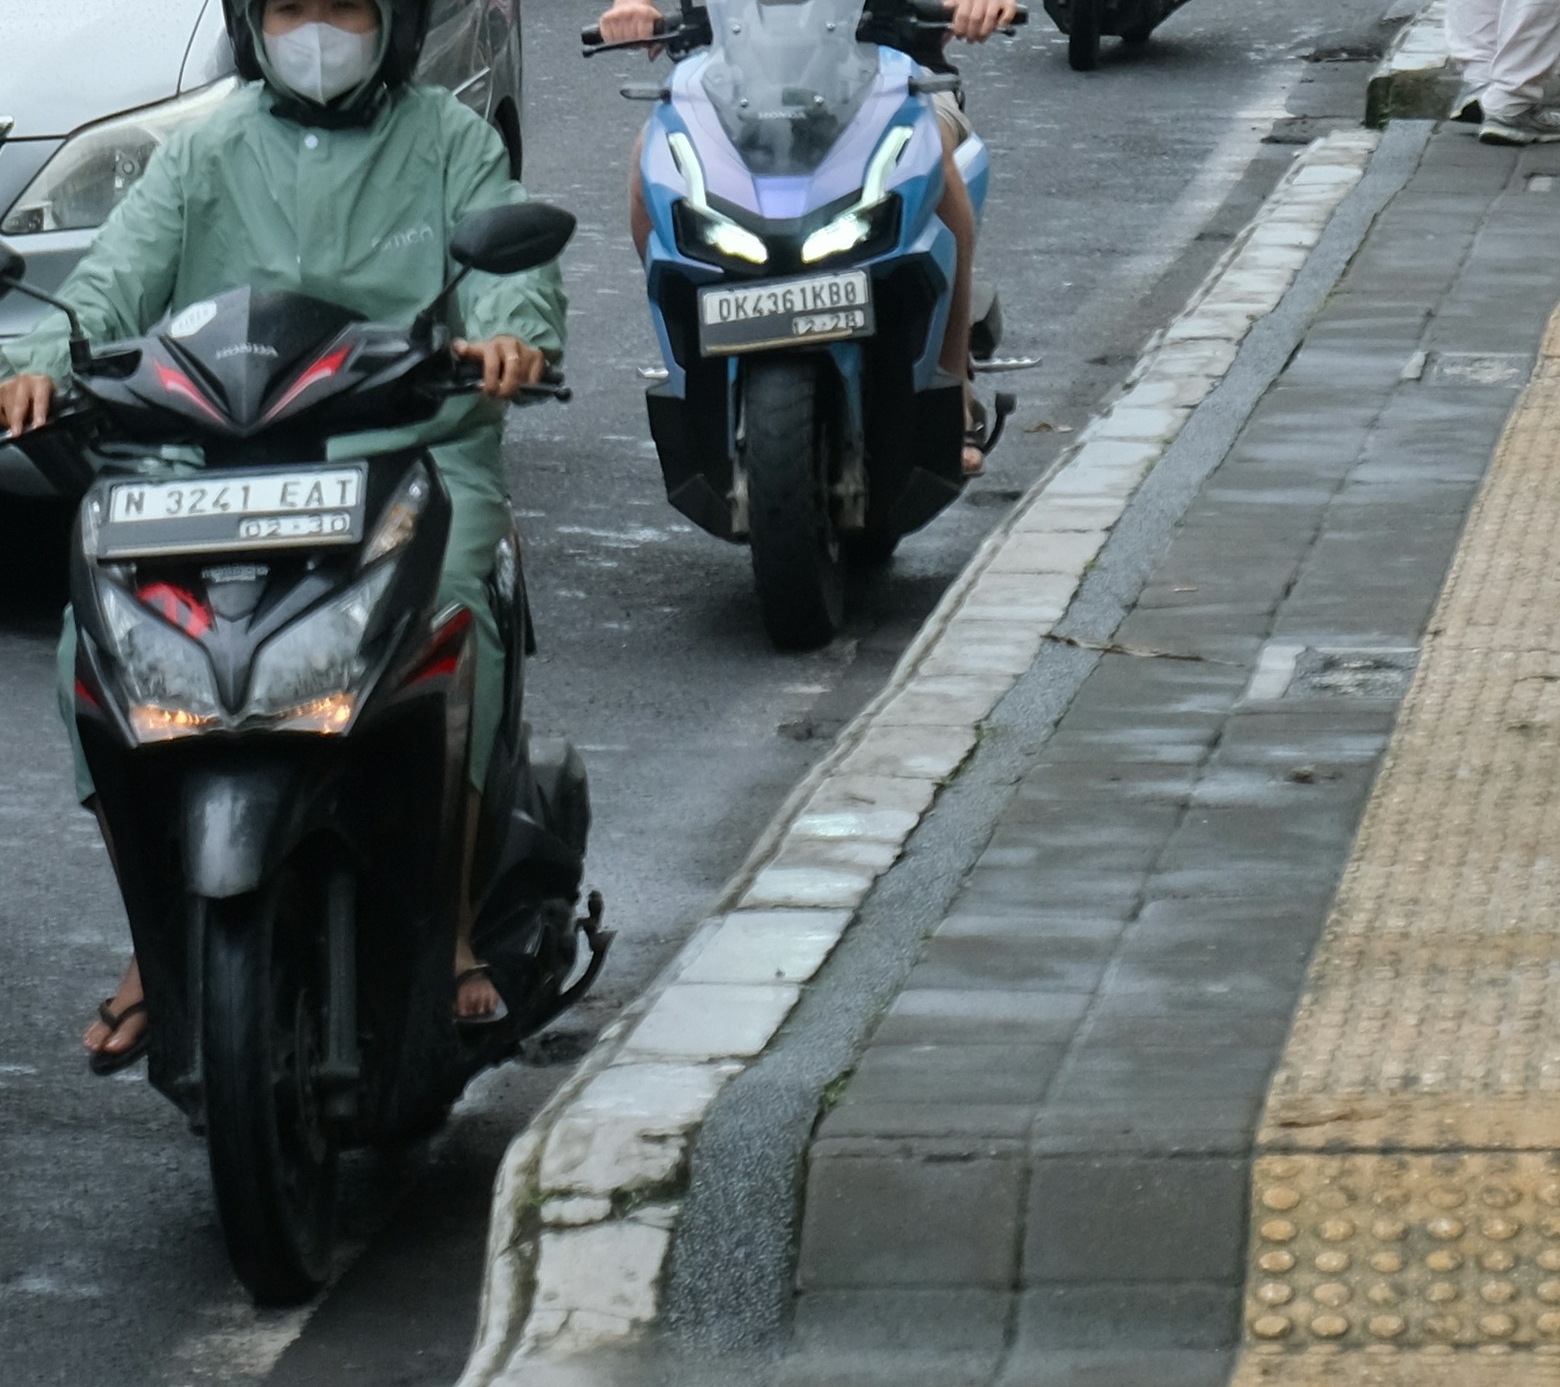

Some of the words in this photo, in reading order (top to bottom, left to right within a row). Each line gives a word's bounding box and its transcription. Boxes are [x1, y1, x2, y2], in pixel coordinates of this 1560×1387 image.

[216, 341, 279, 360] HONDA
[124, 489, 146, 515] N
[165, 484, 252, 516] 3241
[280, 479, 353, 509] EAT
